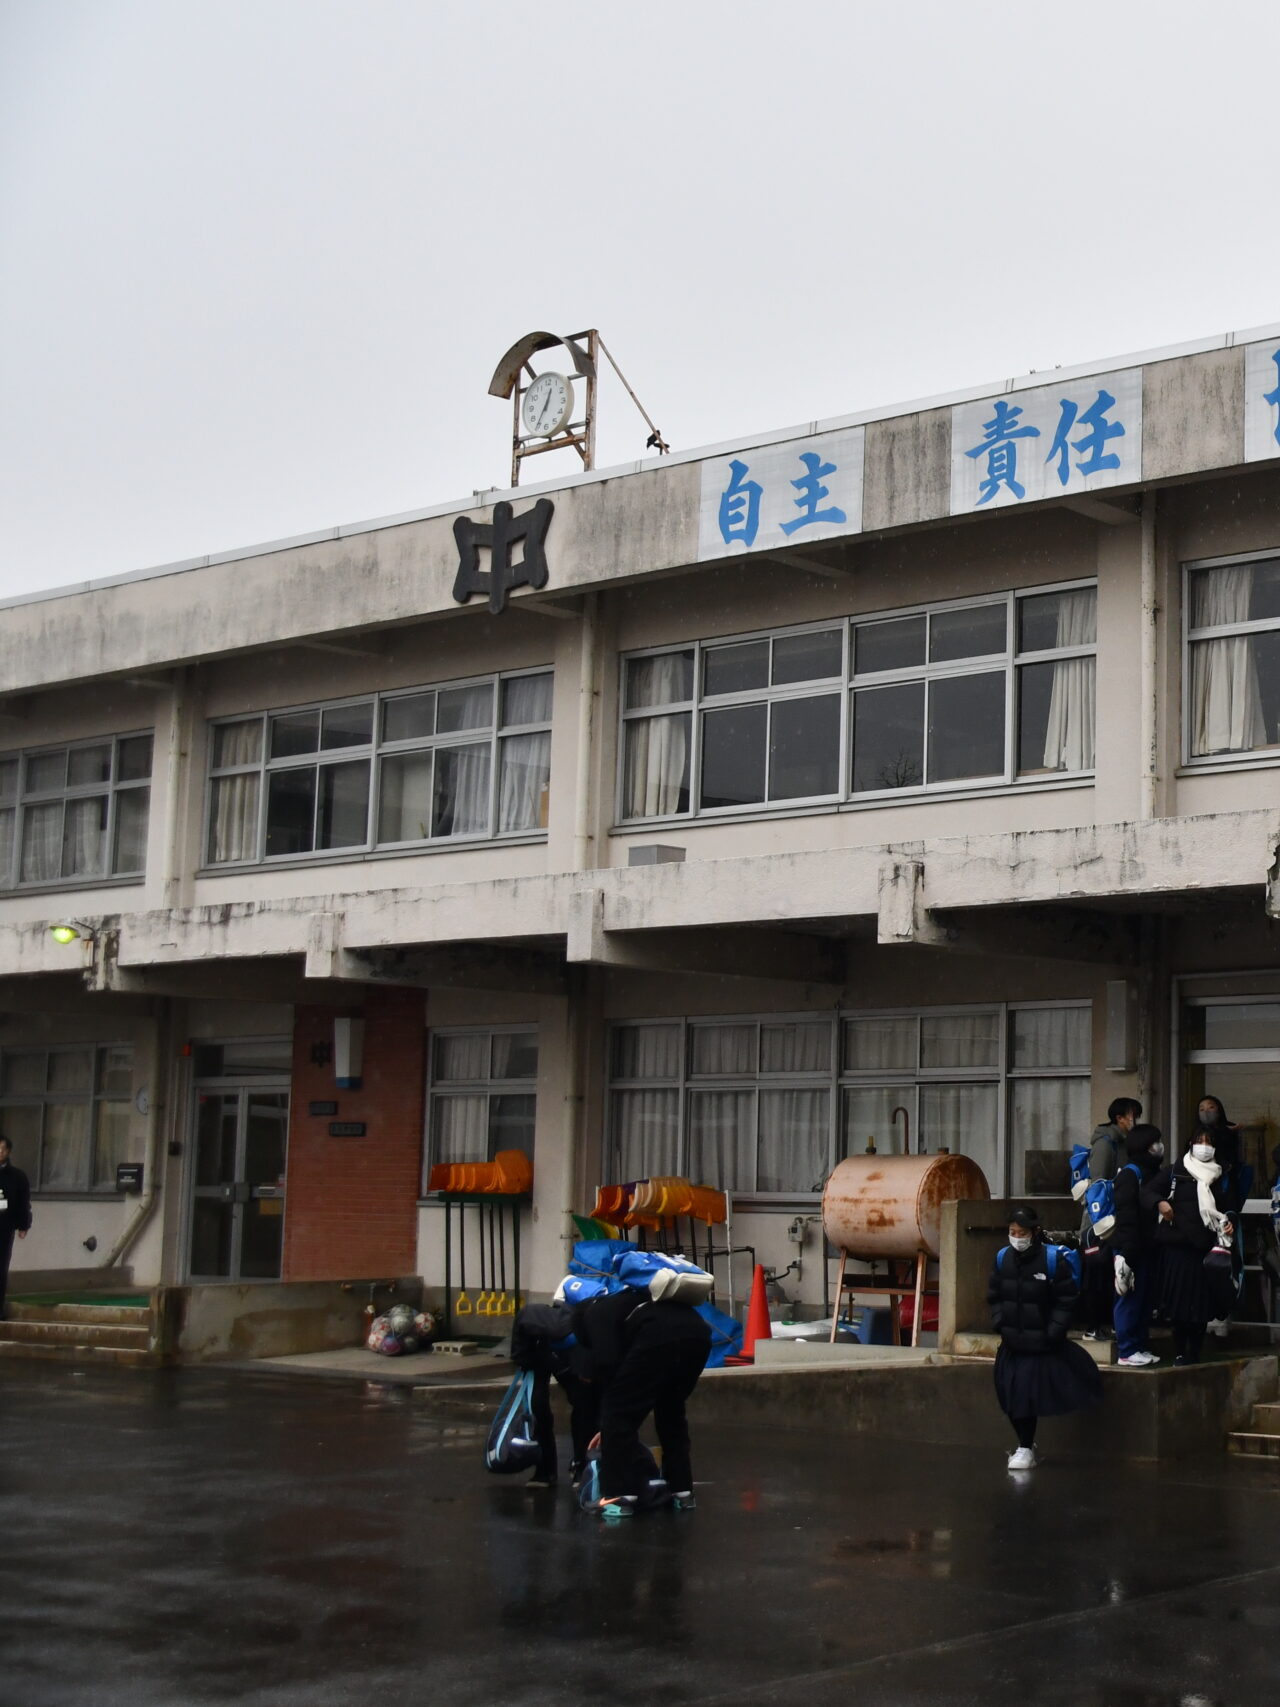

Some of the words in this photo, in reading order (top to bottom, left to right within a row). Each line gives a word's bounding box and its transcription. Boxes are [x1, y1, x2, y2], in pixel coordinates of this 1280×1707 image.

[719, 453, 847, 546] 自主
[966, 390, 1125, 504] 責任
[452, 498, 555, 615] 中
